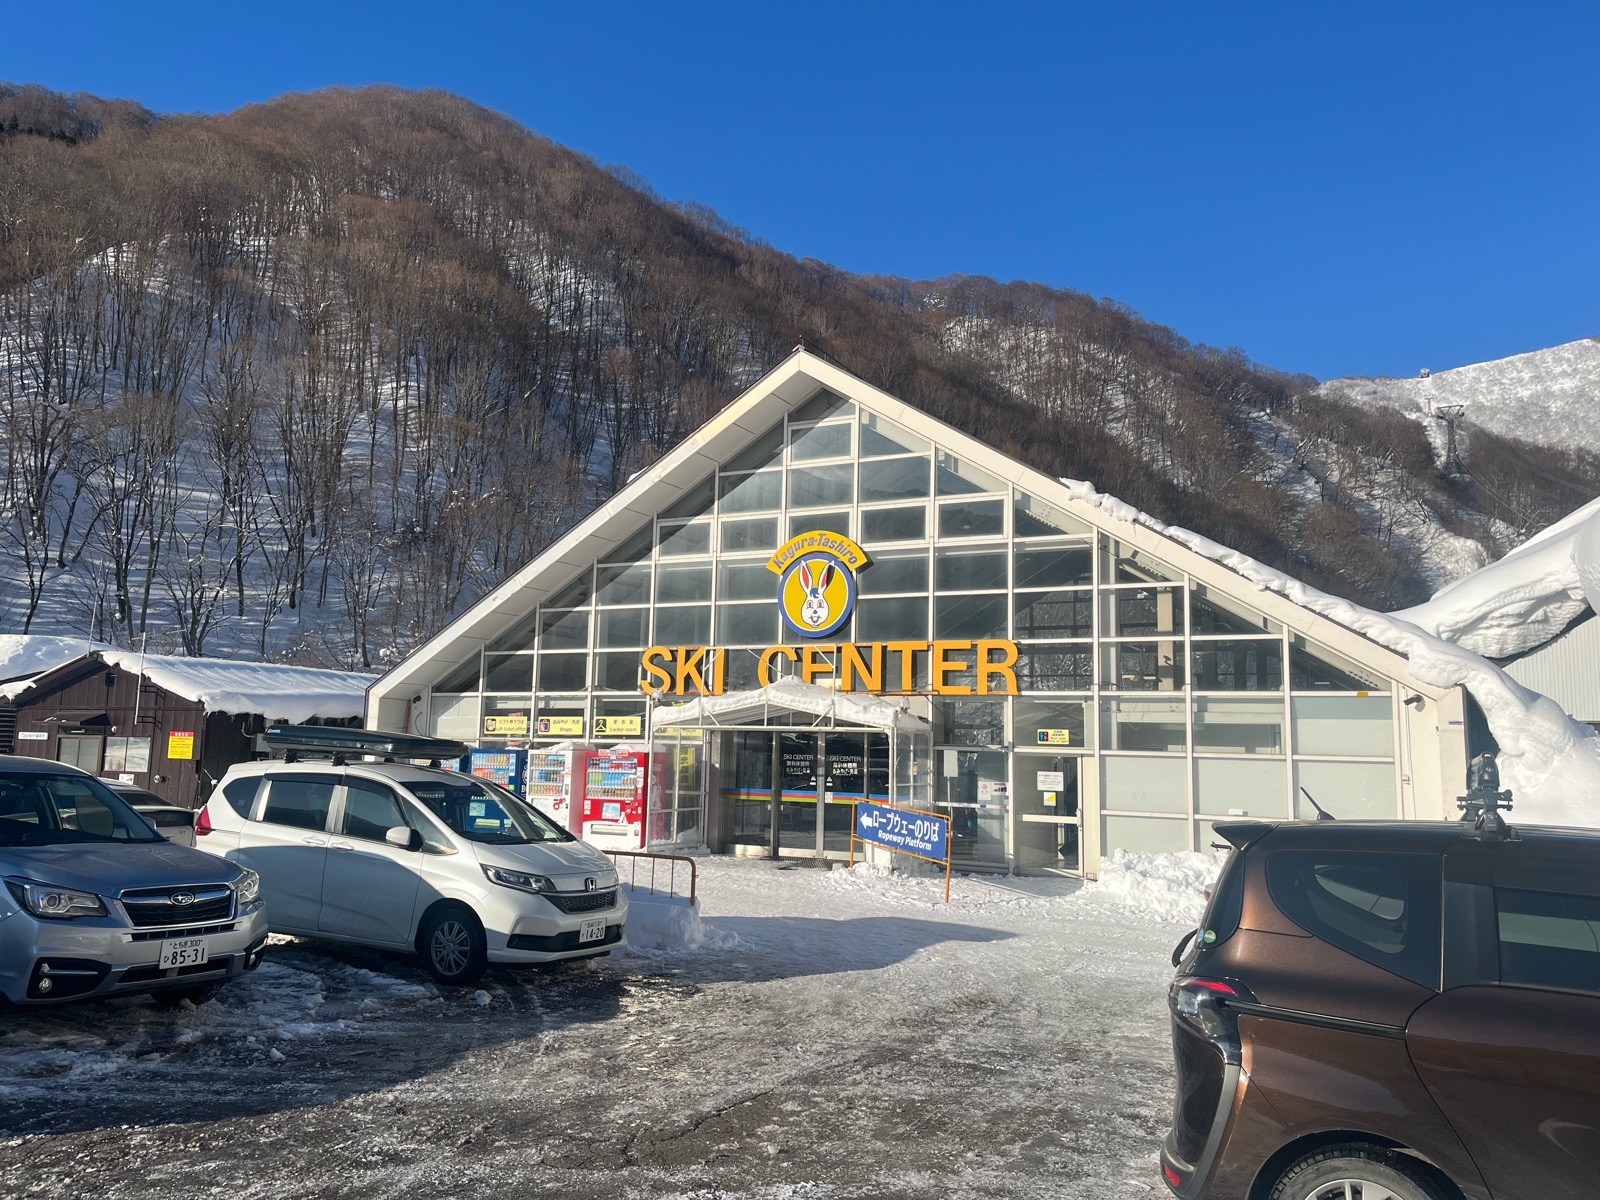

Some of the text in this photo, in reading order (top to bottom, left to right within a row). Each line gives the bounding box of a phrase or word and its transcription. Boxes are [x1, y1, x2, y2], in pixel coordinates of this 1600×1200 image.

[641, 639, 1019, 696] SKI CENTER
[873, 810, 940, 842] ロープウェーのりば
[877, 829, 932, 851] Ropeway Platform
[171, 947, 205, 966] 85-31
